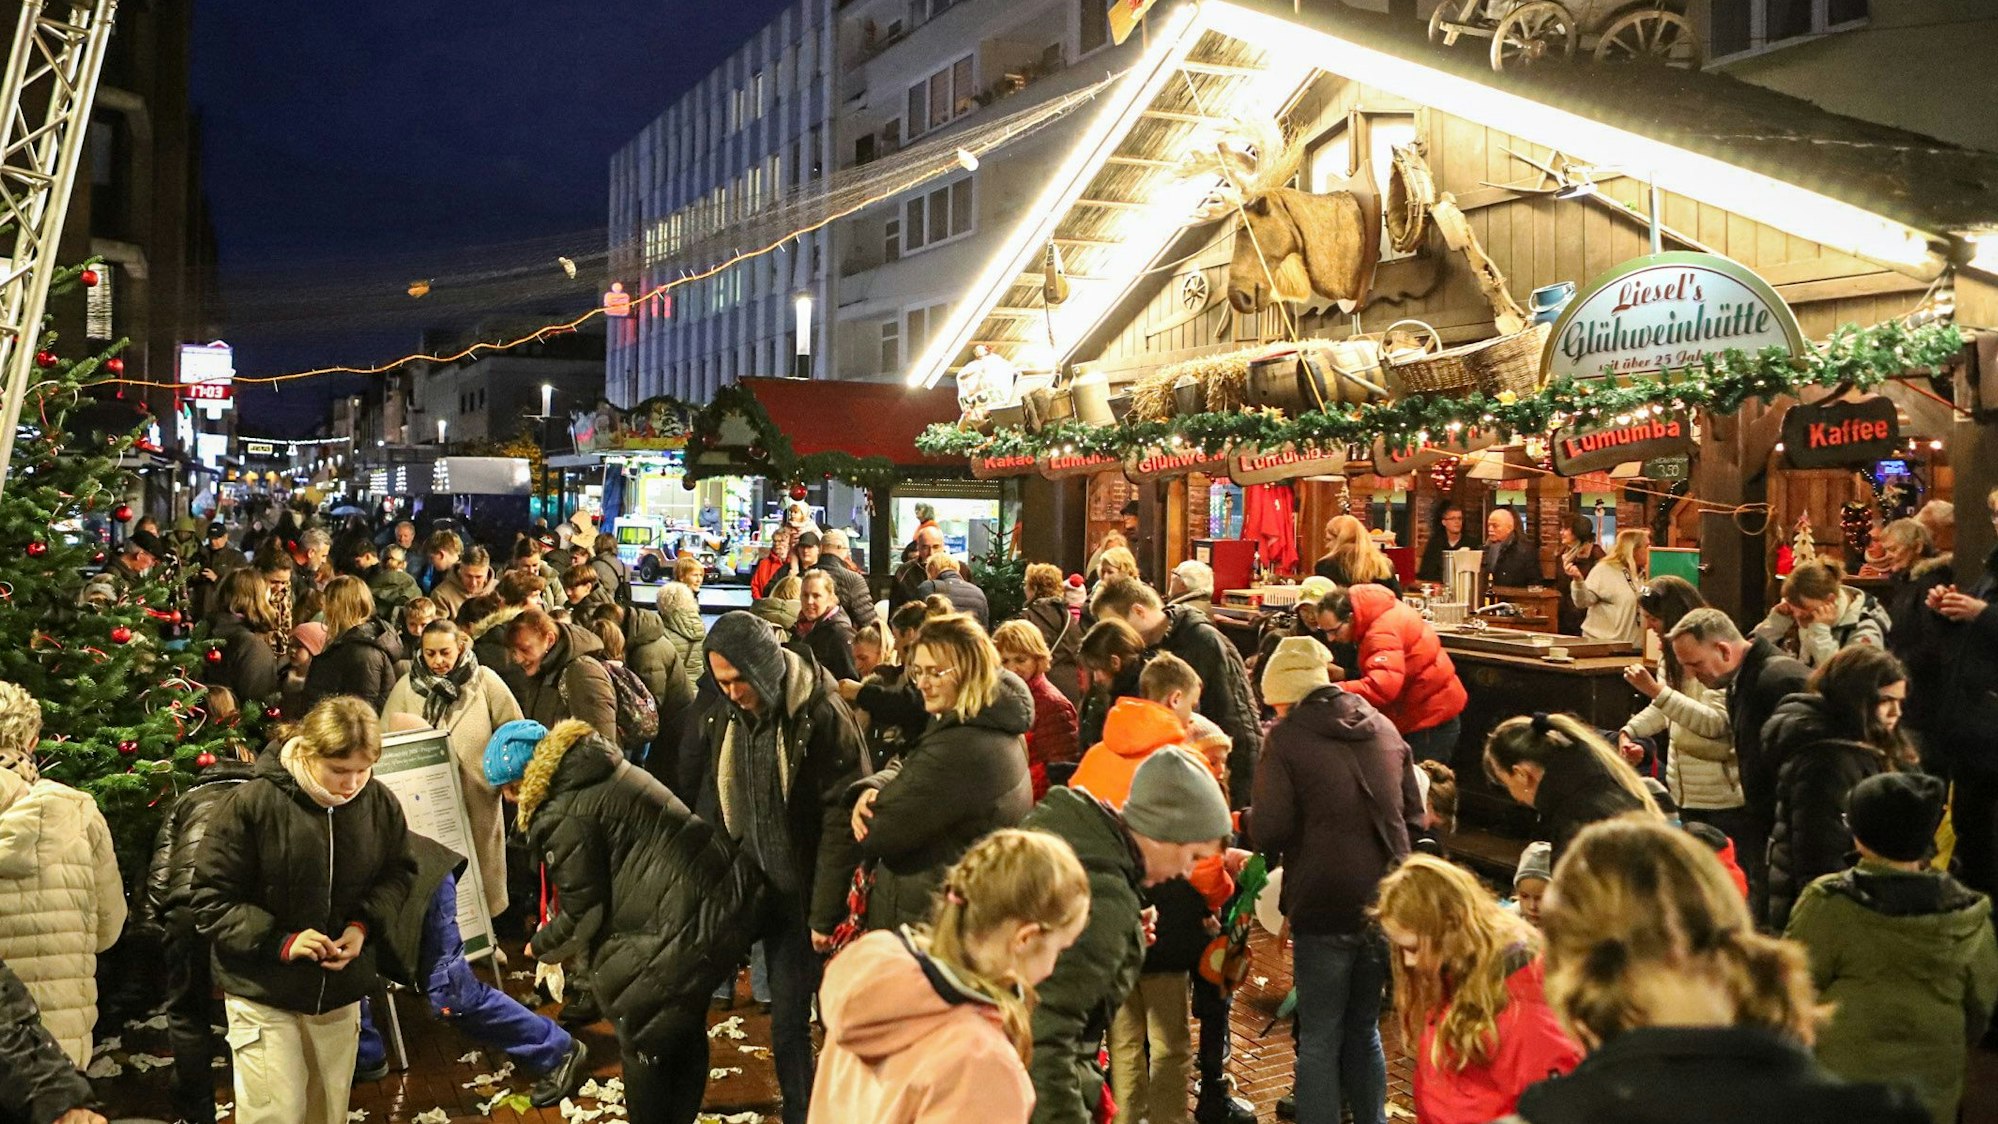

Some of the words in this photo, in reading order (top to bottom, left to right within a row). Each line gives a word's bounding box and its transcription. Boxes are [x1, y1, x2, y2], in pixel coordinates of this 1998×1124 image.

[1611, 273, 1704, 315] Liesel's
[1562, 302, 1769, 366] Glühweinhütte
[1599, 359, 1619, 372] sit
[1622, 356, 1651, 370] über
[1655, 354, 1672, 366] 25
[191, 385, 224, 398] 17:03
[1564, 418, 1681, 460] Lumumba
[1808, 419, 1889, 449] Kaffee
[984, 455, 1035, 470] Kakao
[1239, 447, 1333, 472] Lumumb
